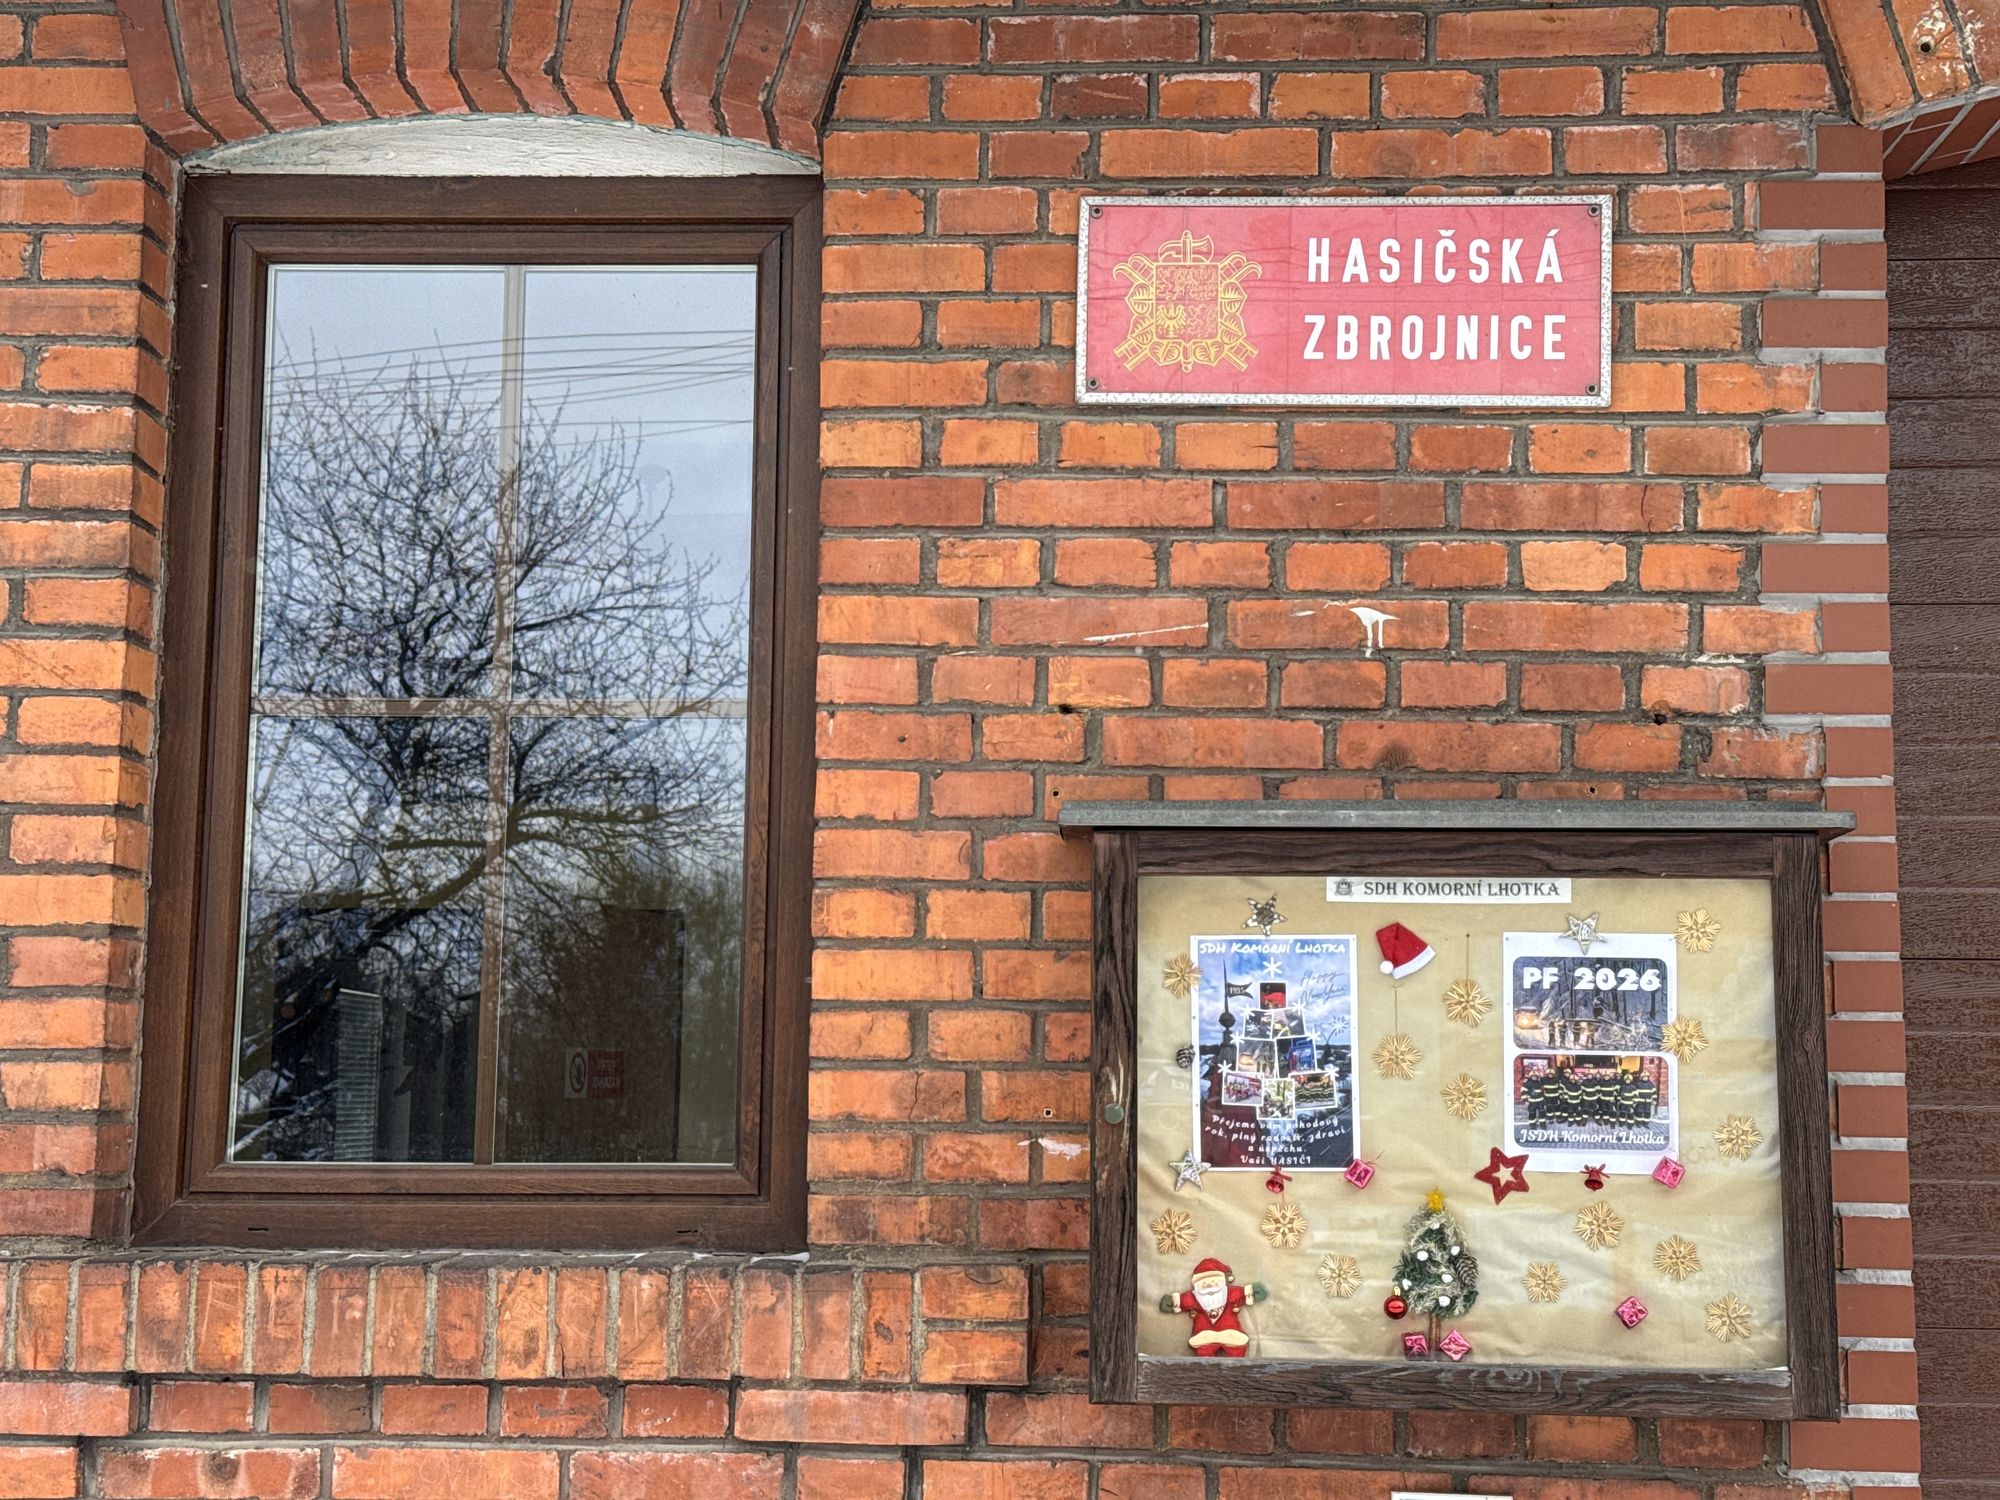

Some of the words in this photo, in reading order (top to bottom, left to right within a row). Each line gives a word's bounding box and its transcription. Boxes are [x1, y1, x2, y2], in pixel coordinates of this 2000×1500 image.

[1306, 227, 1564, 284] HASIČSKÁ
[1303, 314, 1567, 361] ZBROJNICE
[1363, 881, 1397, 897] SDH
[1403, 879, 1483, 897] KOMORNÍ
[1488, 882, 1560, 897] LHOTKA
[1199, 942, 1226, 955] SDH
[1300, 970, 1347, 987] Happy
[1522, 967, 1560, 990] PF
[1573, 967, 1662, 992] 2026
[1211, 1114, 1256, 1130] Přejeme
[1286, 1115, 1339, 1132] pohodový
[1231, 1131, 1257, 1144] plný
[1519, 1128, 1560, 1143] JSDH
[1560, 1128, 1618, 1144] Komorní
[1618, 1131, 1666, 1145] Lhotka
[1239, 1154, 1265, 1165] Vaši
